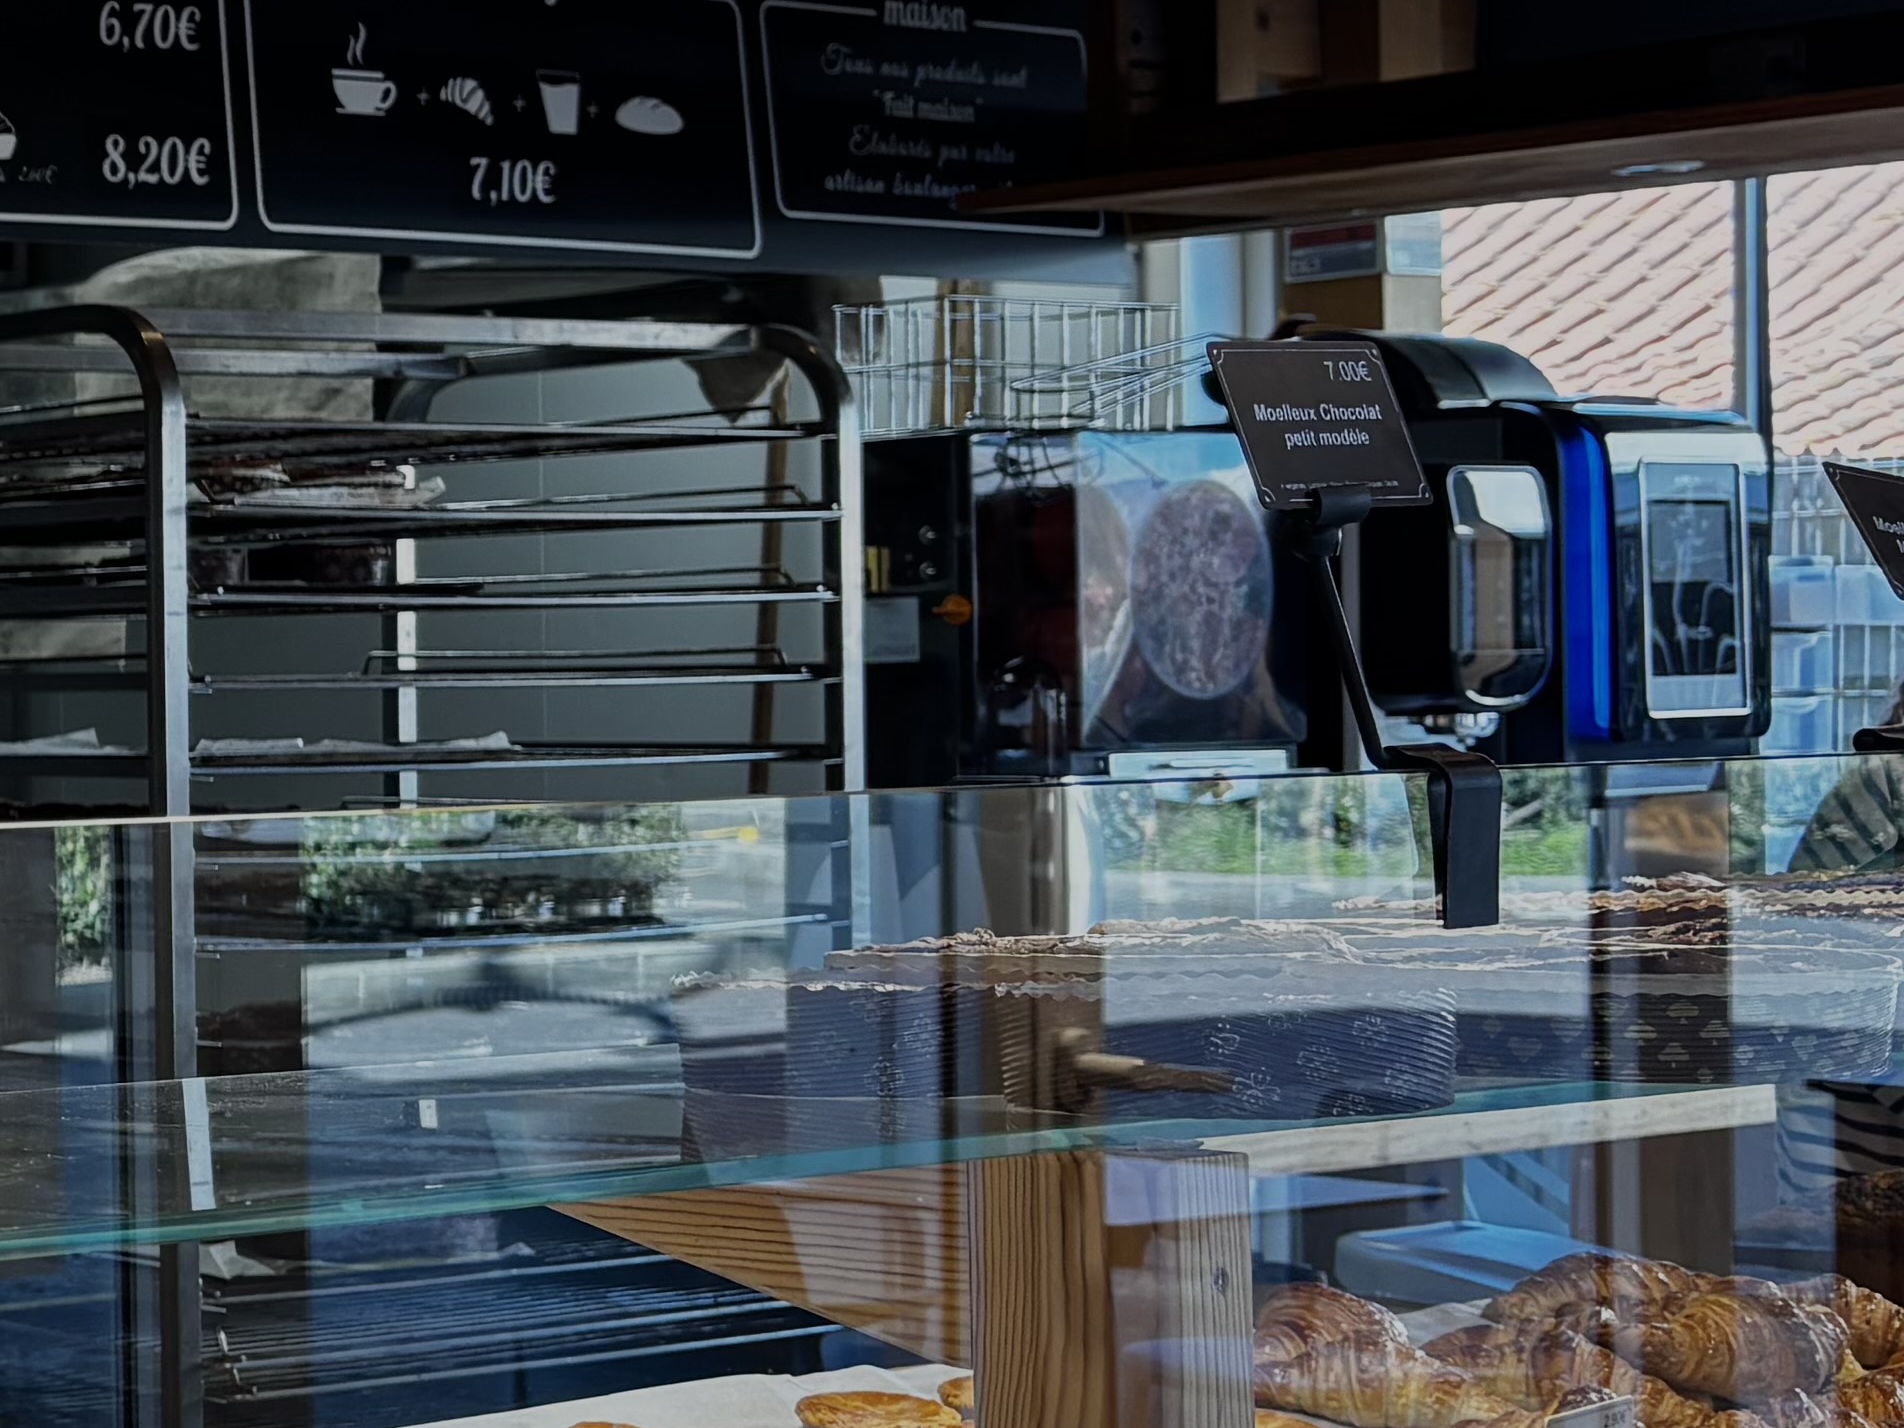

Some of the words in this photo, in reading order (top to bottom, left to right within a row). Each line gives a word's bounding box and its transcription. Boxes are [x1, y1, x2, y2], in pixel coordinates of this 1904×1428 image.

[99, 1, 202, 52] 6,70€
[101, 133, 212, 190] 8,20€
[468, 155, 559, 206] 7,10€
[1323, 360, 1373, 382] 7.00€
[1253, 403, 1317, 422] Moelleux
[1319, 402, 1383, 422] Chocolat
[1284, 429, 1317, 450] petit
[1319, 427, 1371, 447] modèle
